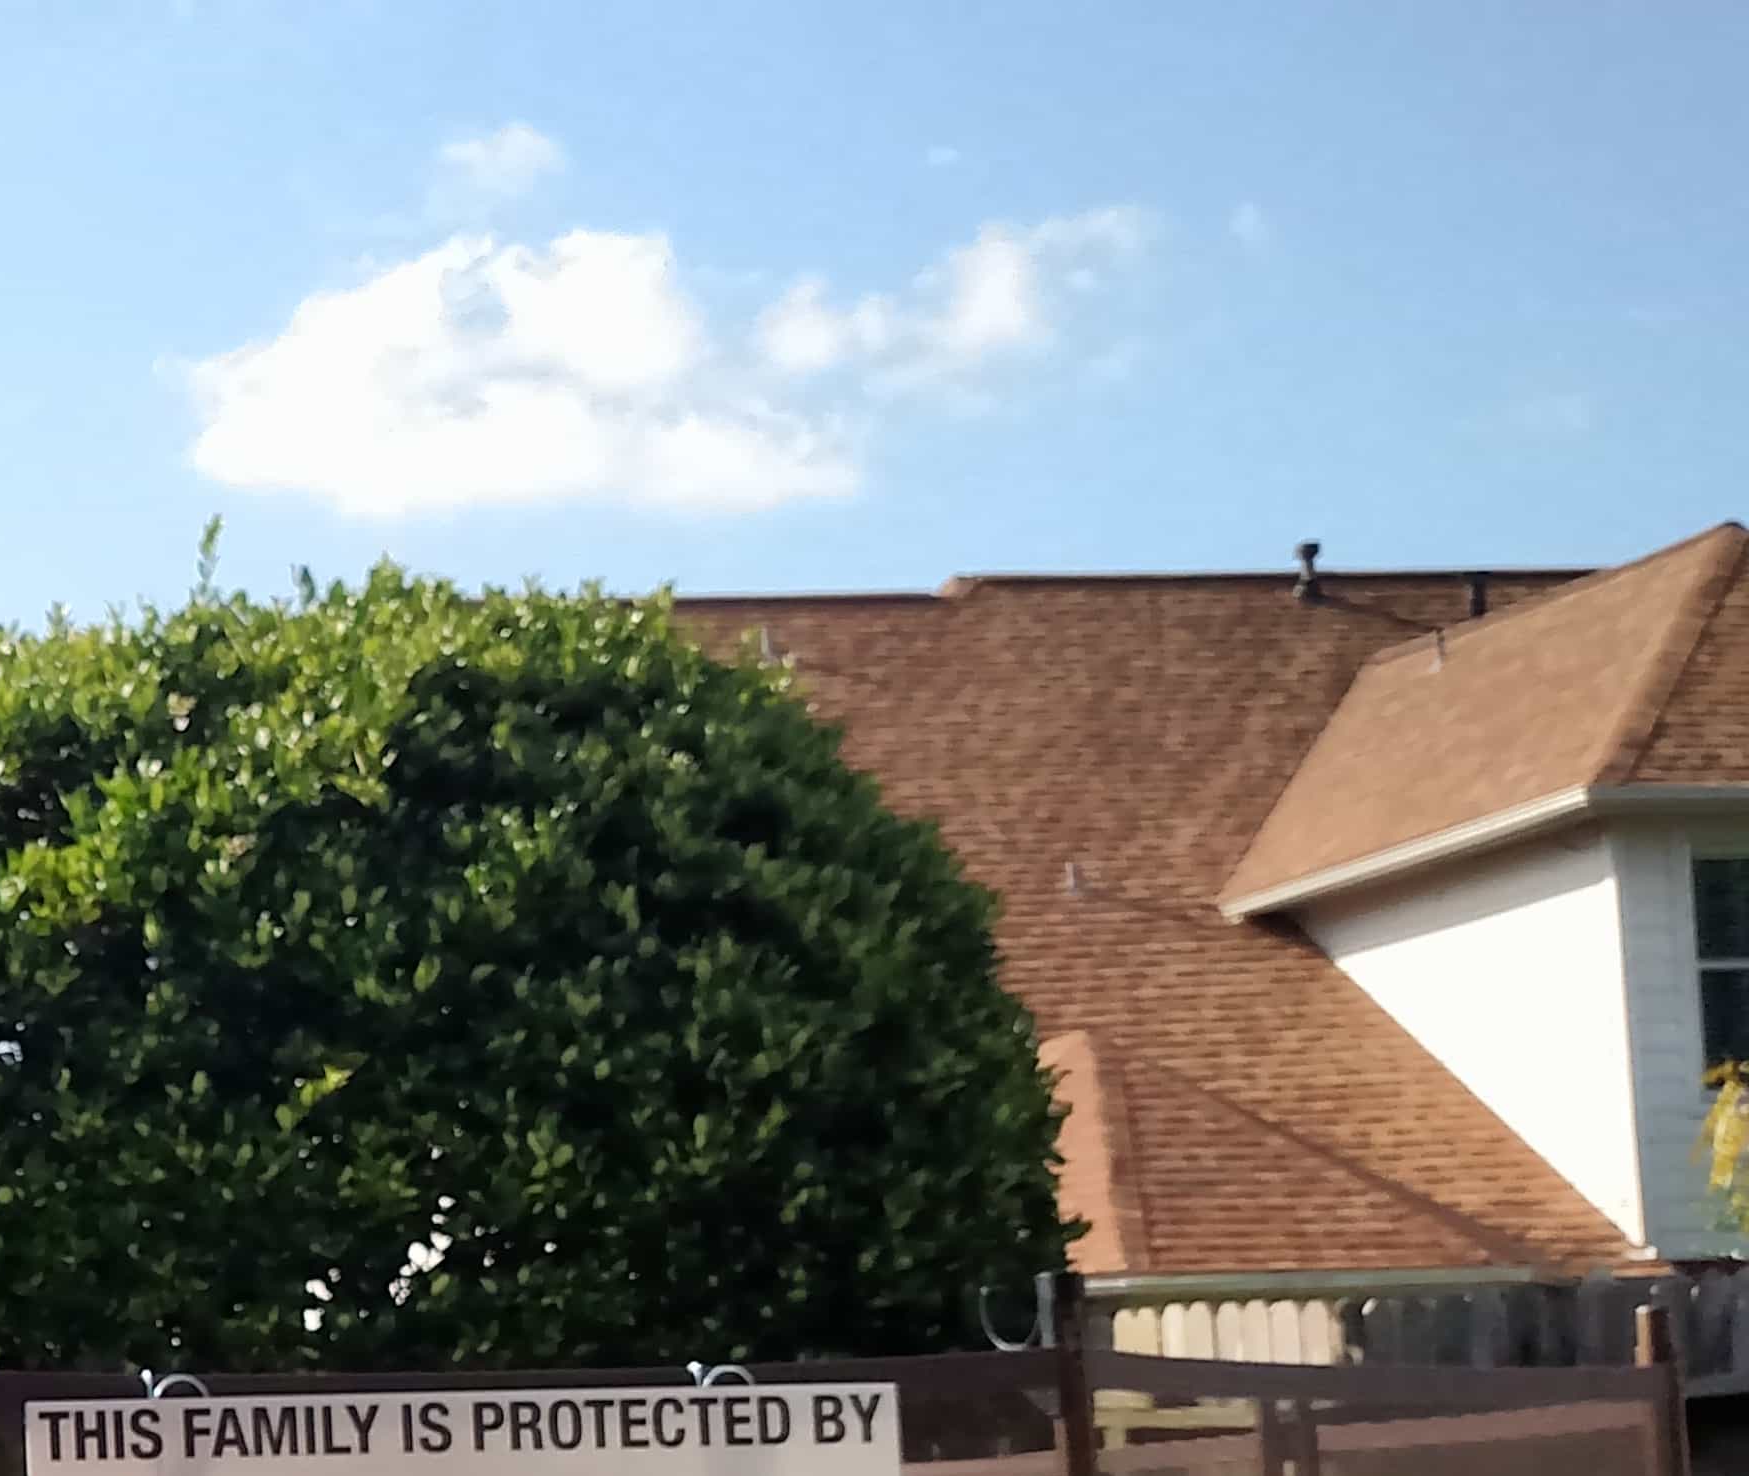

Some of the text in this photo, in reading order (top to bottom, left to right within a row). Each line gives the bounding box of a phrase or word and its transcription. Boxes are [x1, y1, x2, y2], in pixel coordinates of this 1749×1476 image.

[38, 1394, 881, 1460] THIS FAMILY IS PROTECTED BY
